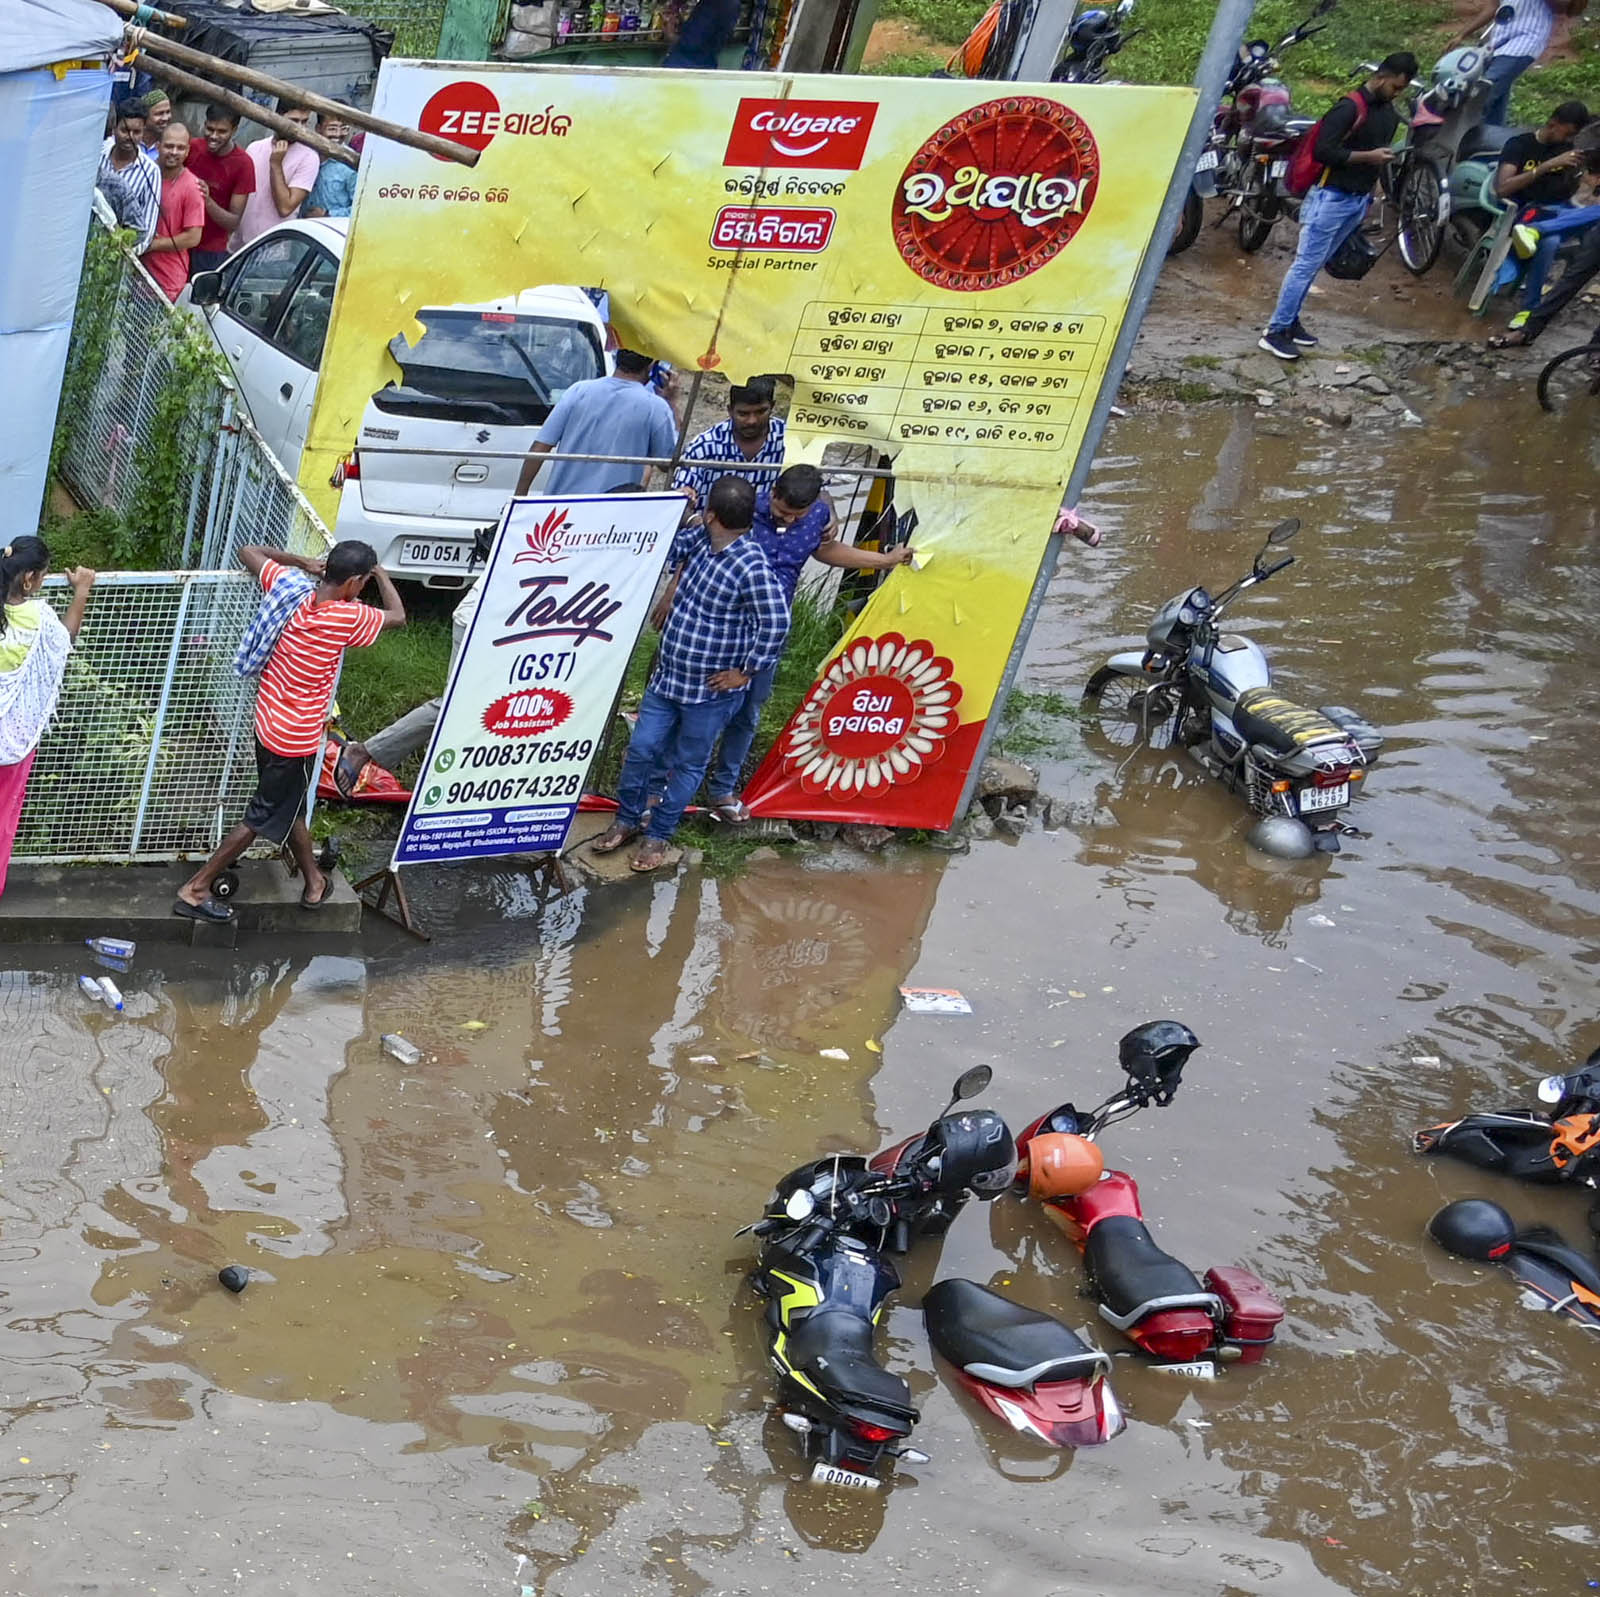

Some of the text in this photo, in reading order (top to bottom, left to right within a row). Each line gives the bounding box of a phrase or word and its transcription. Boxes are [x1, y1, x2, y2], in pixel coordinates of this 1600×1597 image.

[440, 110, 500, 134] ZEE
[504, 105, 572, 136] ସାର୍ଥକ
[750, 111, 858, 137] Colgate
[785, 176, 846, 196] ନିବେଦନ
[903, 166, 1089, 227] ରଥଯାତ୍ରା
[707, 256, 818, 271] Special Partner
[547, 524, 658, 556] gurucharya
[434, 545, 460, 562] 05A
[504, 575, 622, 647] Tally
[509, 652, 576, 684] (GST)
[505, 694, 554, 718] 100%
[852, 690, 893, 713] ସିଧା
[492, 718, 556, 730] Job Assistant
[828, 715, 904, 736] ପ୍ରସାରଣ
[460, 739, 593, 769] 7008376549
[446, 774, 580, 804] 9040674328
